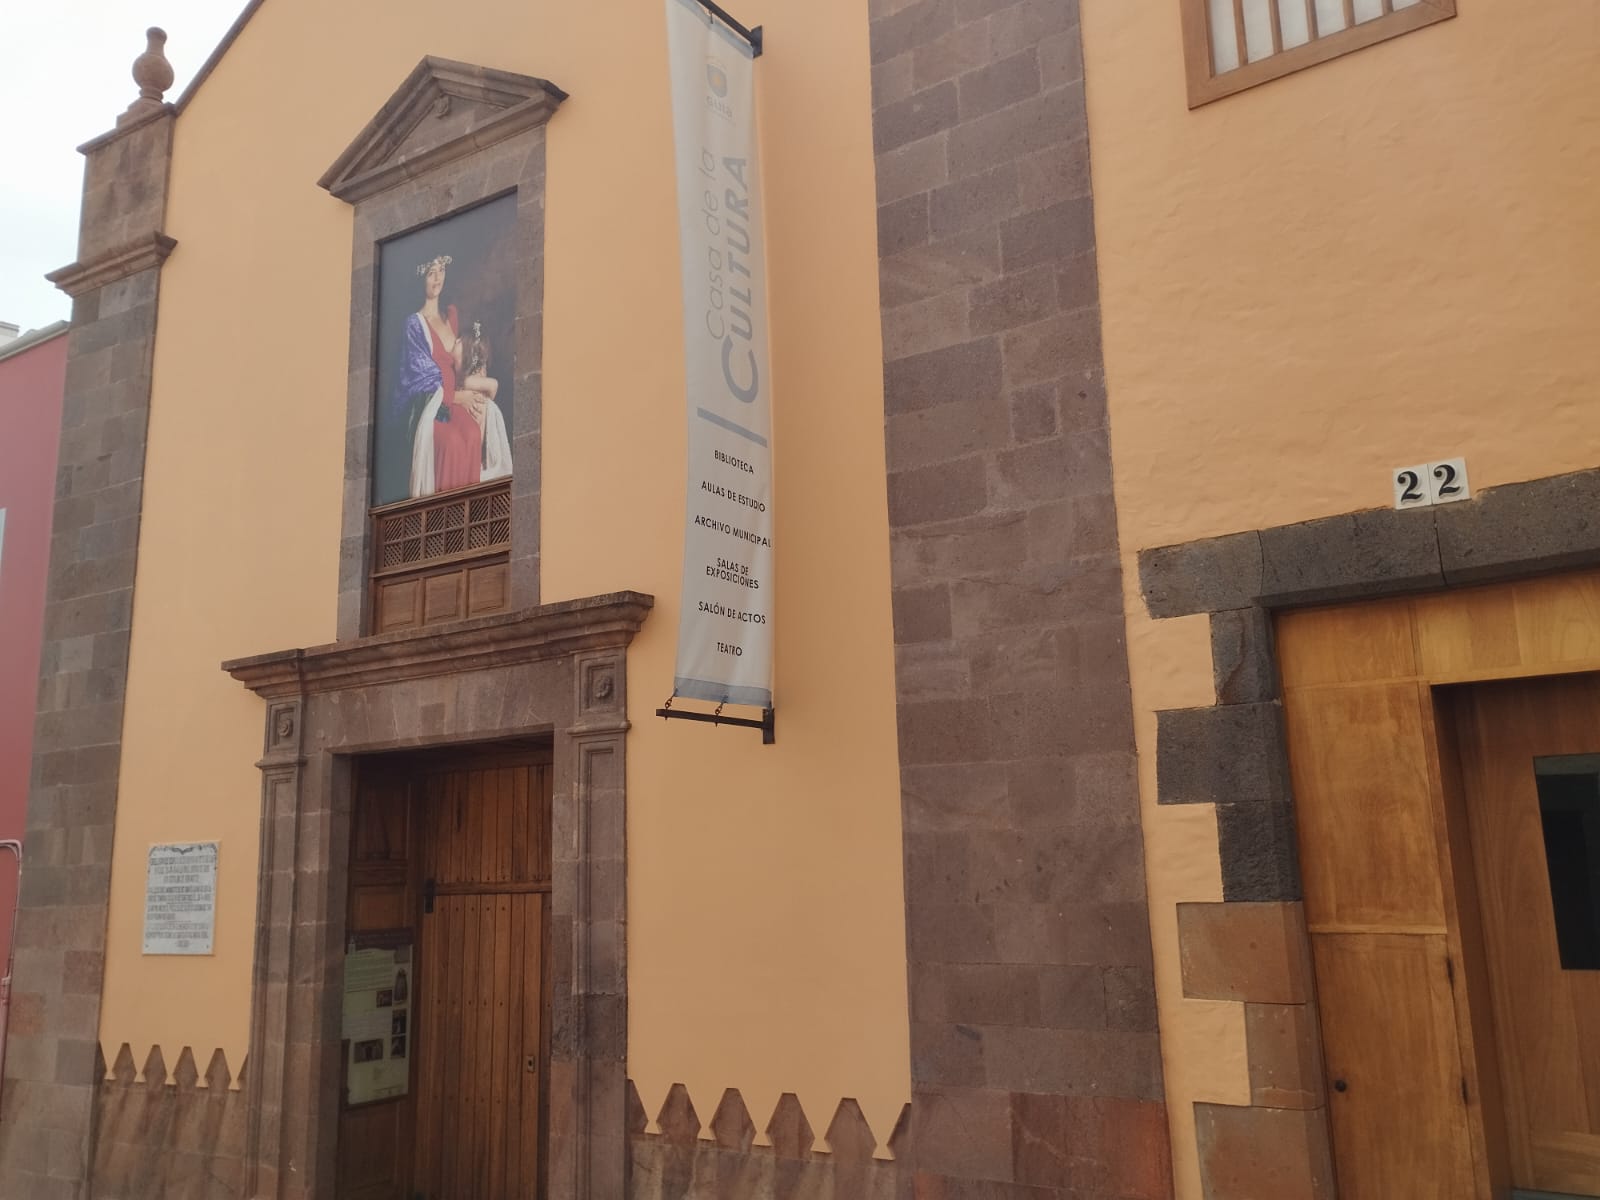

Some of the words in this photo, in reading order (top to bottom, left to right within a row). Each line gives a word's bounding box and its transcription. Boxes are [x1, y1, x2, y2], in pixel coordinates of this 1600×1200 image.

[698, 146, 716, 181] la
[702, 190, 720, 236] de
[706, 245, 725, 340] Casa
[721, 157, 759, 404] CULTURA
[714, 449, 755, 475] BIBLIOTECA
[701, 480, 725, 498] AULAS
[727, 489, 737, 502] DE
[738, 494, 766, 512] ESTUDIO
[1397, 464, 1461, 503] 22
[694, 515, 731, 535] ARCHIVO
[732, 527, 772, 548] MUNICIPAL
[706, 566, 759, 590] EXPOSICIONES
[717, 557, 739, 573] SALAS
[740, 565, 749, 576] DE
[698, 601, 725, 617] SALÓN
[727, 608, 736, 619] DE
[737, 611, 766, 624] ACTOS
[717, 641, 743, 657] TEATRO
